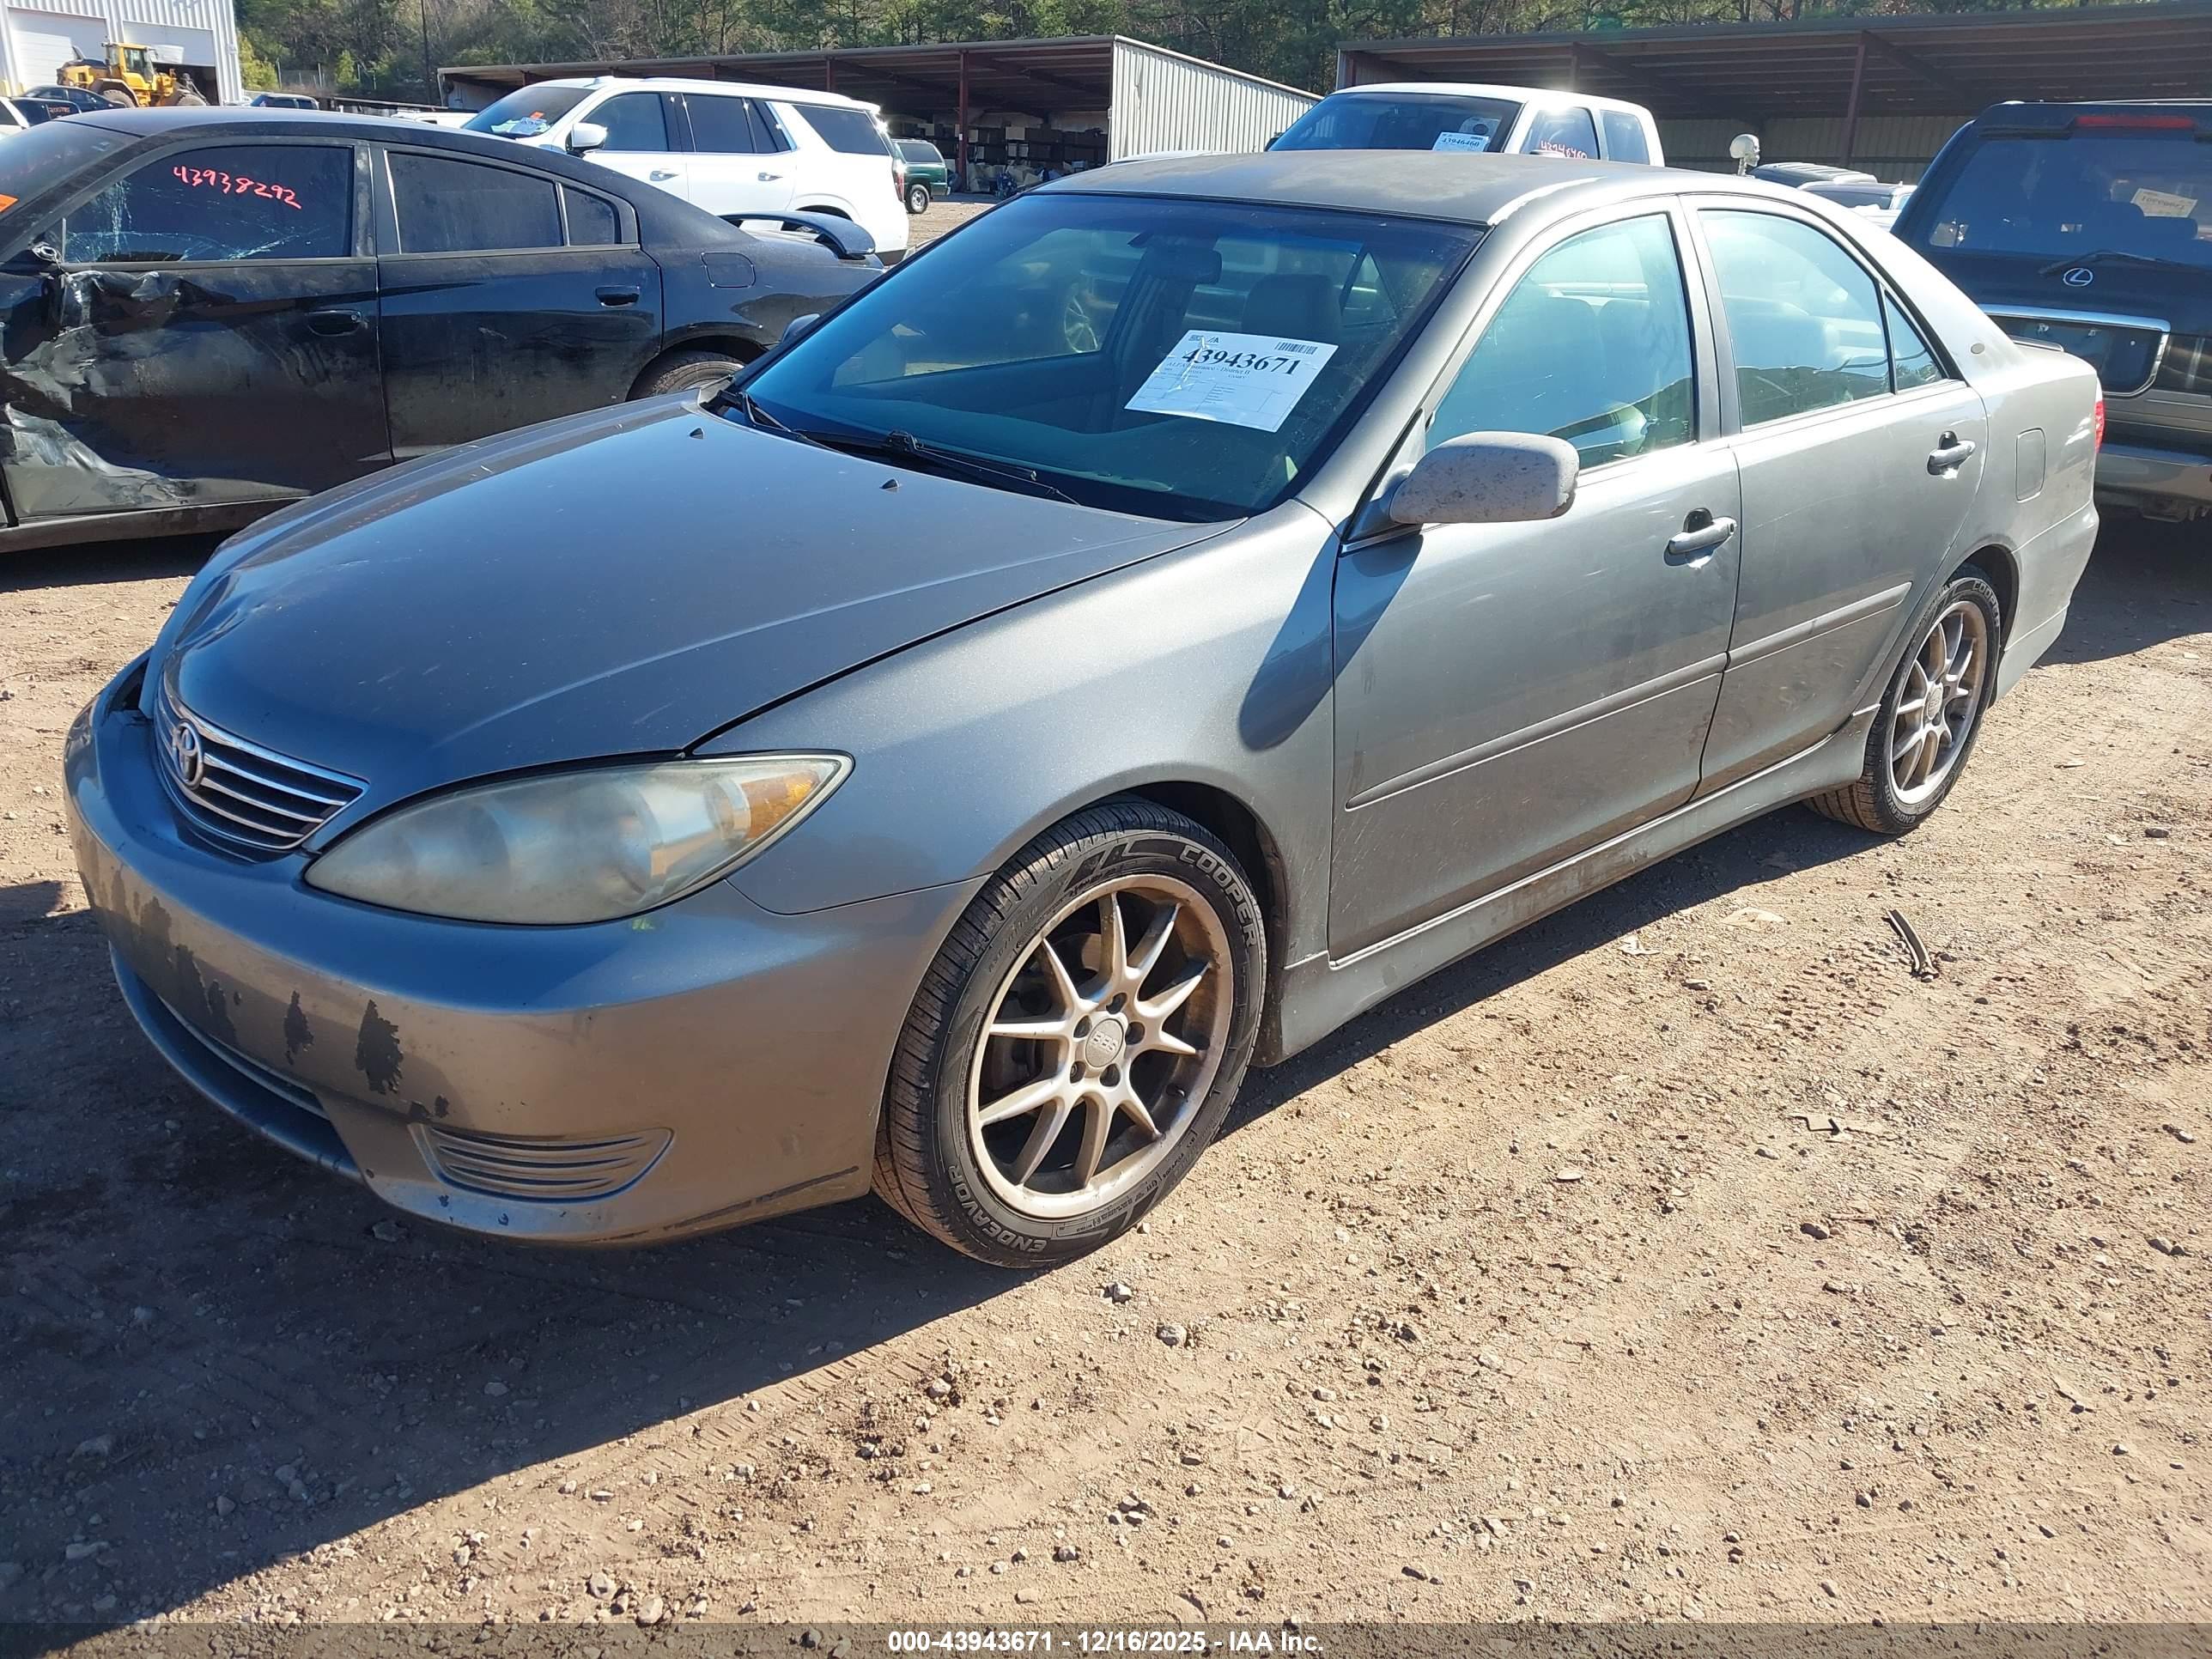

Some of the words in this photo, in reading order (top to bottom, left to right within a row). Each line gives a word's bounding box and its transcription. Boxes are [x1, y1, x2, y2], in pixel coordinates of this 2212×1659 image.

[173, 166, 301, 210] 43938292
[1182, 348, 1302, 375] 43943671
[1179, 844, 1257, 947] COOPER
[1090, 1030, 1119, 1054] BBS
[948, 1165, 1047, 1253] ENDEAVOR
